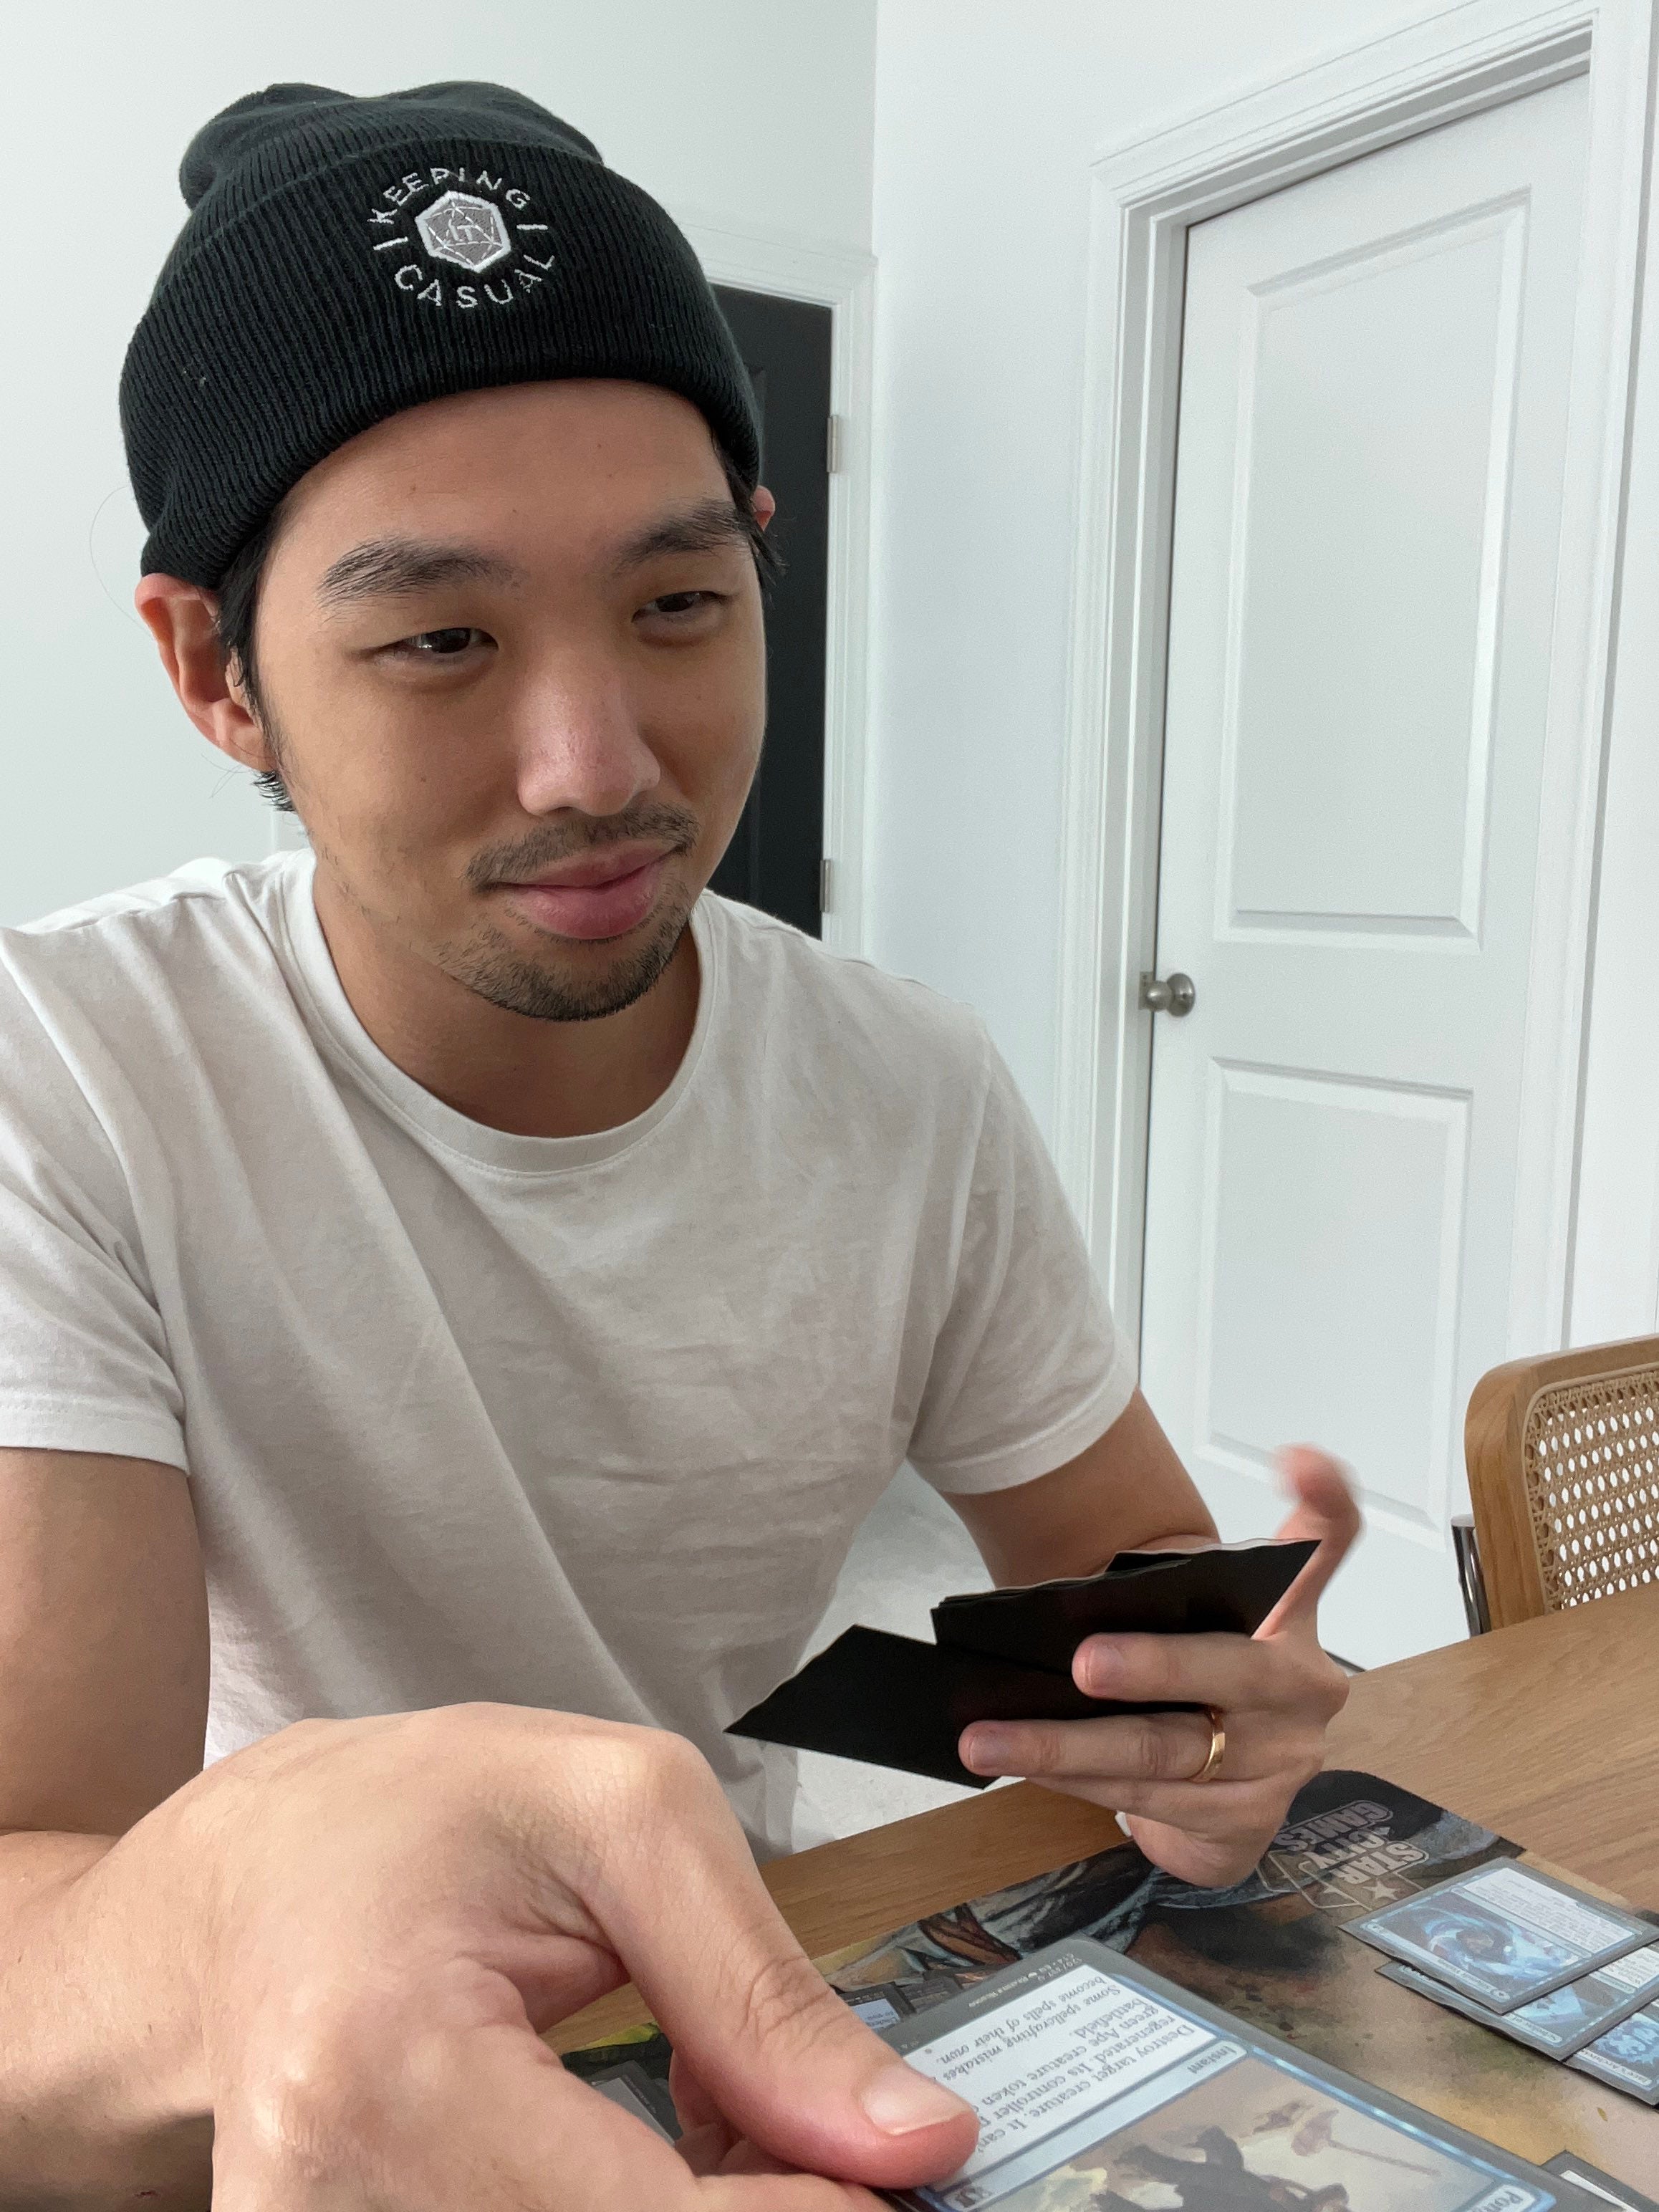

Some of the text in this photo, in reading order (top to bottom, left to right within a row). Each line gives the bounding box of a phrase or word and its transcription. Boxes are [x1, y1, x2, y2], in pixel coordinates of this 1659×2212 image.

[367, 167, 531, 225] KEEPING
[394, 255, 555, 309] CASUAL
[1274, 1803, 1388, 1852] GAMES
[1302, 1830, 1385, 1870] CITY
[1328, 1843, 1423, 1885] STAR
[1058, 1976, 1107, 2002] become
[1006, 2019, 1020, 2032] of
[1022, 2000, 1056, 2021] spells
[1069, 1998, 1148, 2039] battlefield.
[943, 1985, 1121, 2081] Some spellcrafting mistakes
[973, 2027, 1004, 2047] their
[1135, 2024, 1195, 2058] Destroy
[936, 2044, 969, 2064] own.
[981, 2006, 1159, 2105] green Ape creature token
[993, 2015, 1175, 2120] regenerated. Its controller
[1091, 2057, 1137, 2082] target
[1186, 2045, 1238, 2074] Instant
[1024, 2081, 1091, 2117] creature.
[1006, 2119, 1026, 2130] It
